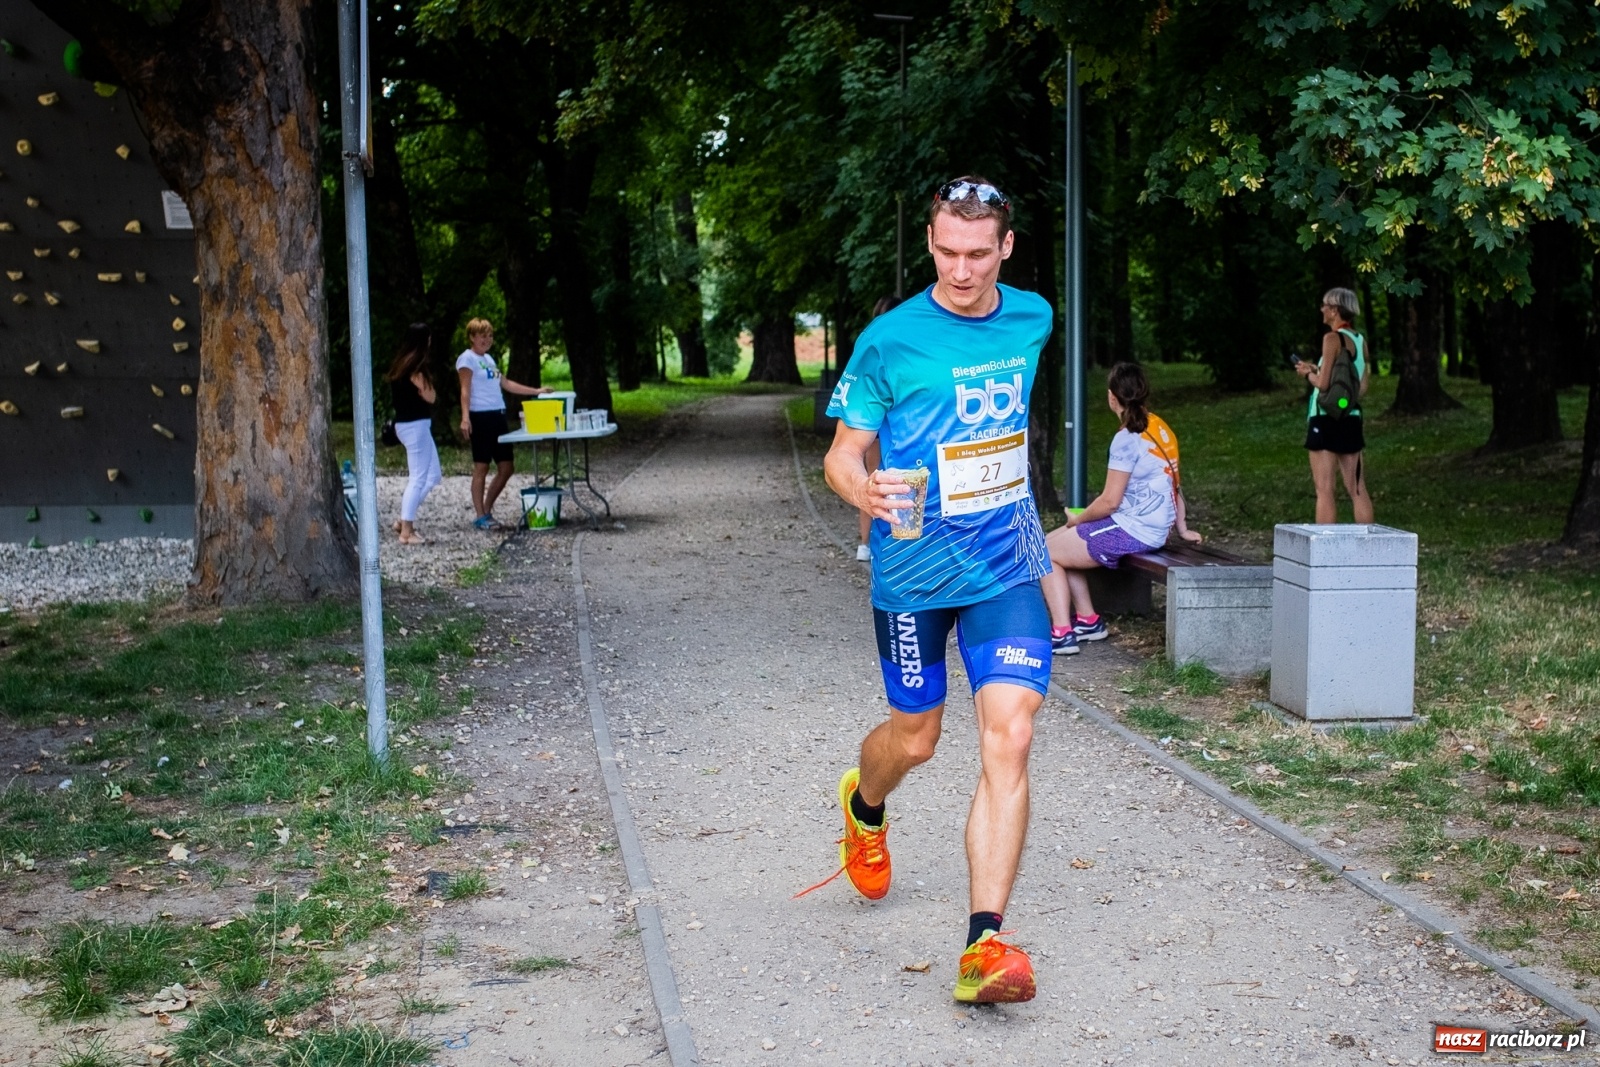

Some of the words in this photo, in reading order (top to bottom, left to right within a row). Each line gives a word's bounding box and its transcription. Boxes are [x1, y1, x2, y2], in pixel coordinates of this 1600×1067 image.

[955, 373, 1026, 425] bbl
[980, 462, 1002, 483] 27
[887, 611, 895, 636] OKNA
[890, 639, 898, 664] TEAM
